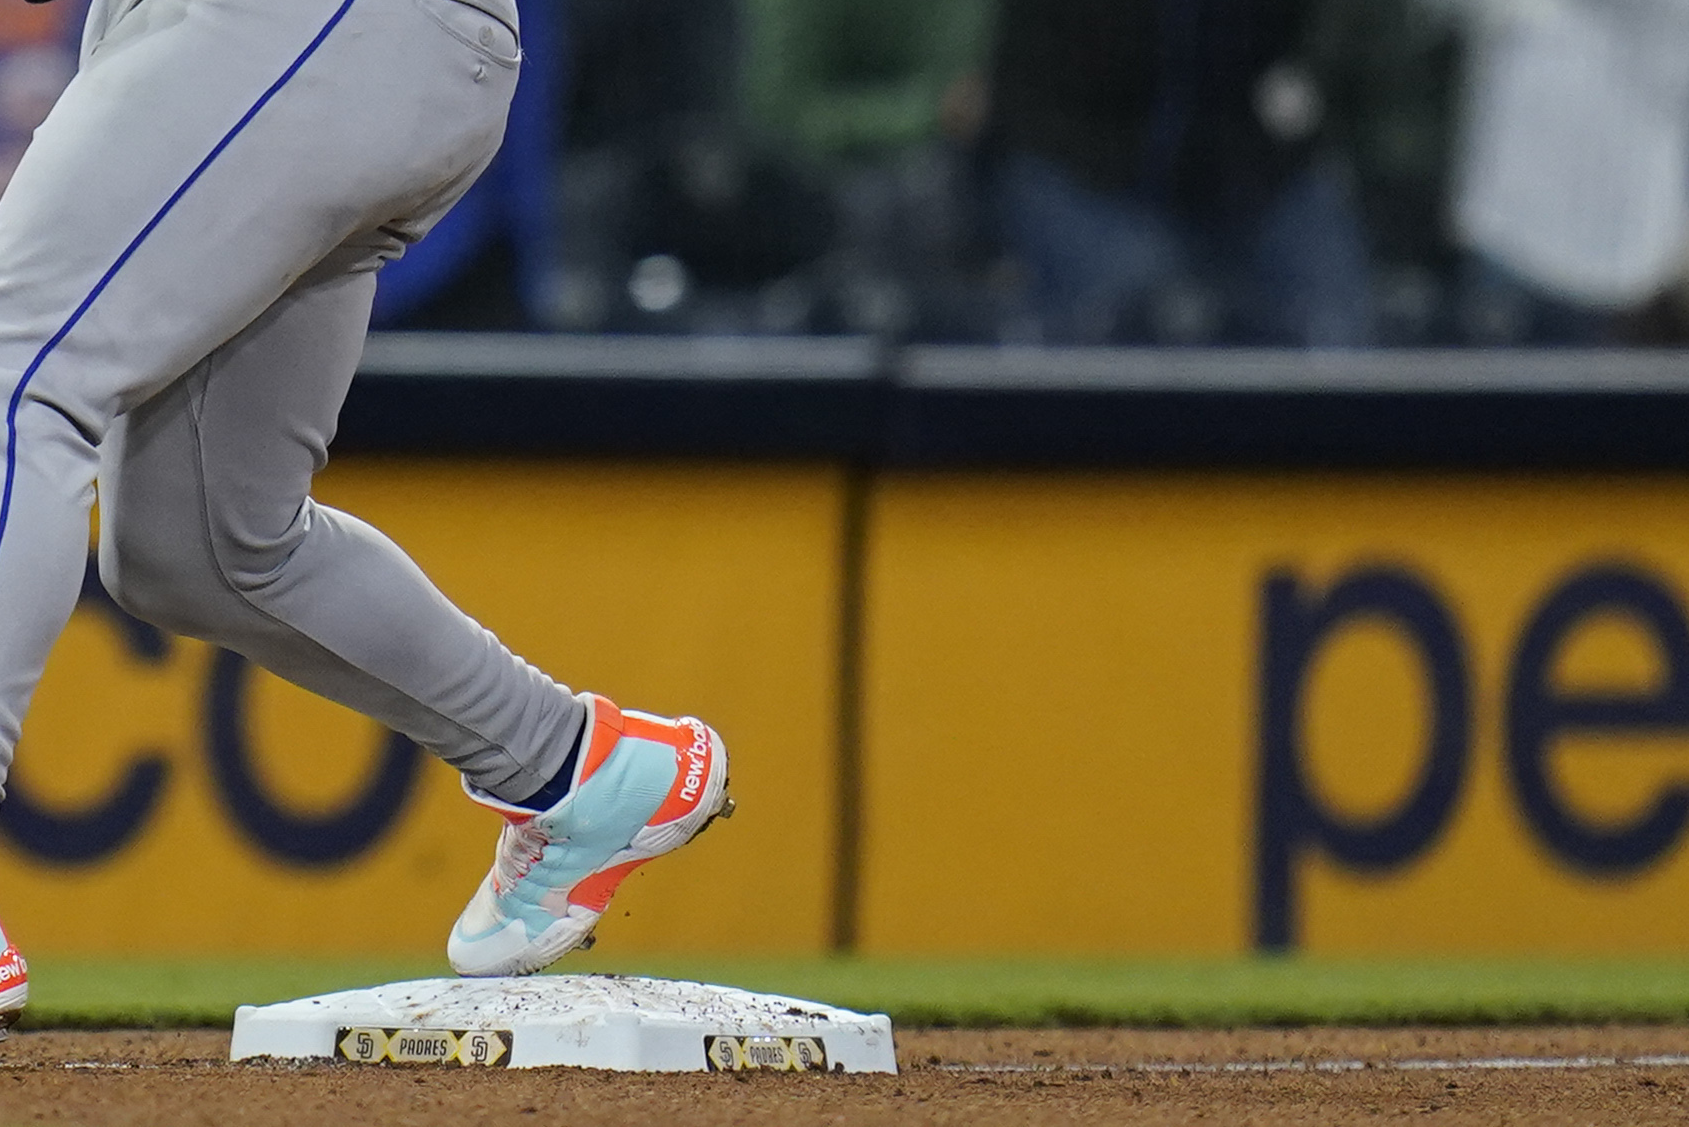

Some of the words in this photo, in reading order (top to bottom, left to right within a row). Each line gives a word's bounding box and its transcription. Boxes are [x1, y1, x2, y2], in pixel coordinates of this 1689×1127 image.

[1252, 560, 1689, 958] pe
[680, 756, 705, 801] new
[399, 1038, 448, 1056] PADRES
[750, 1046, 784, 1064] PADRES
